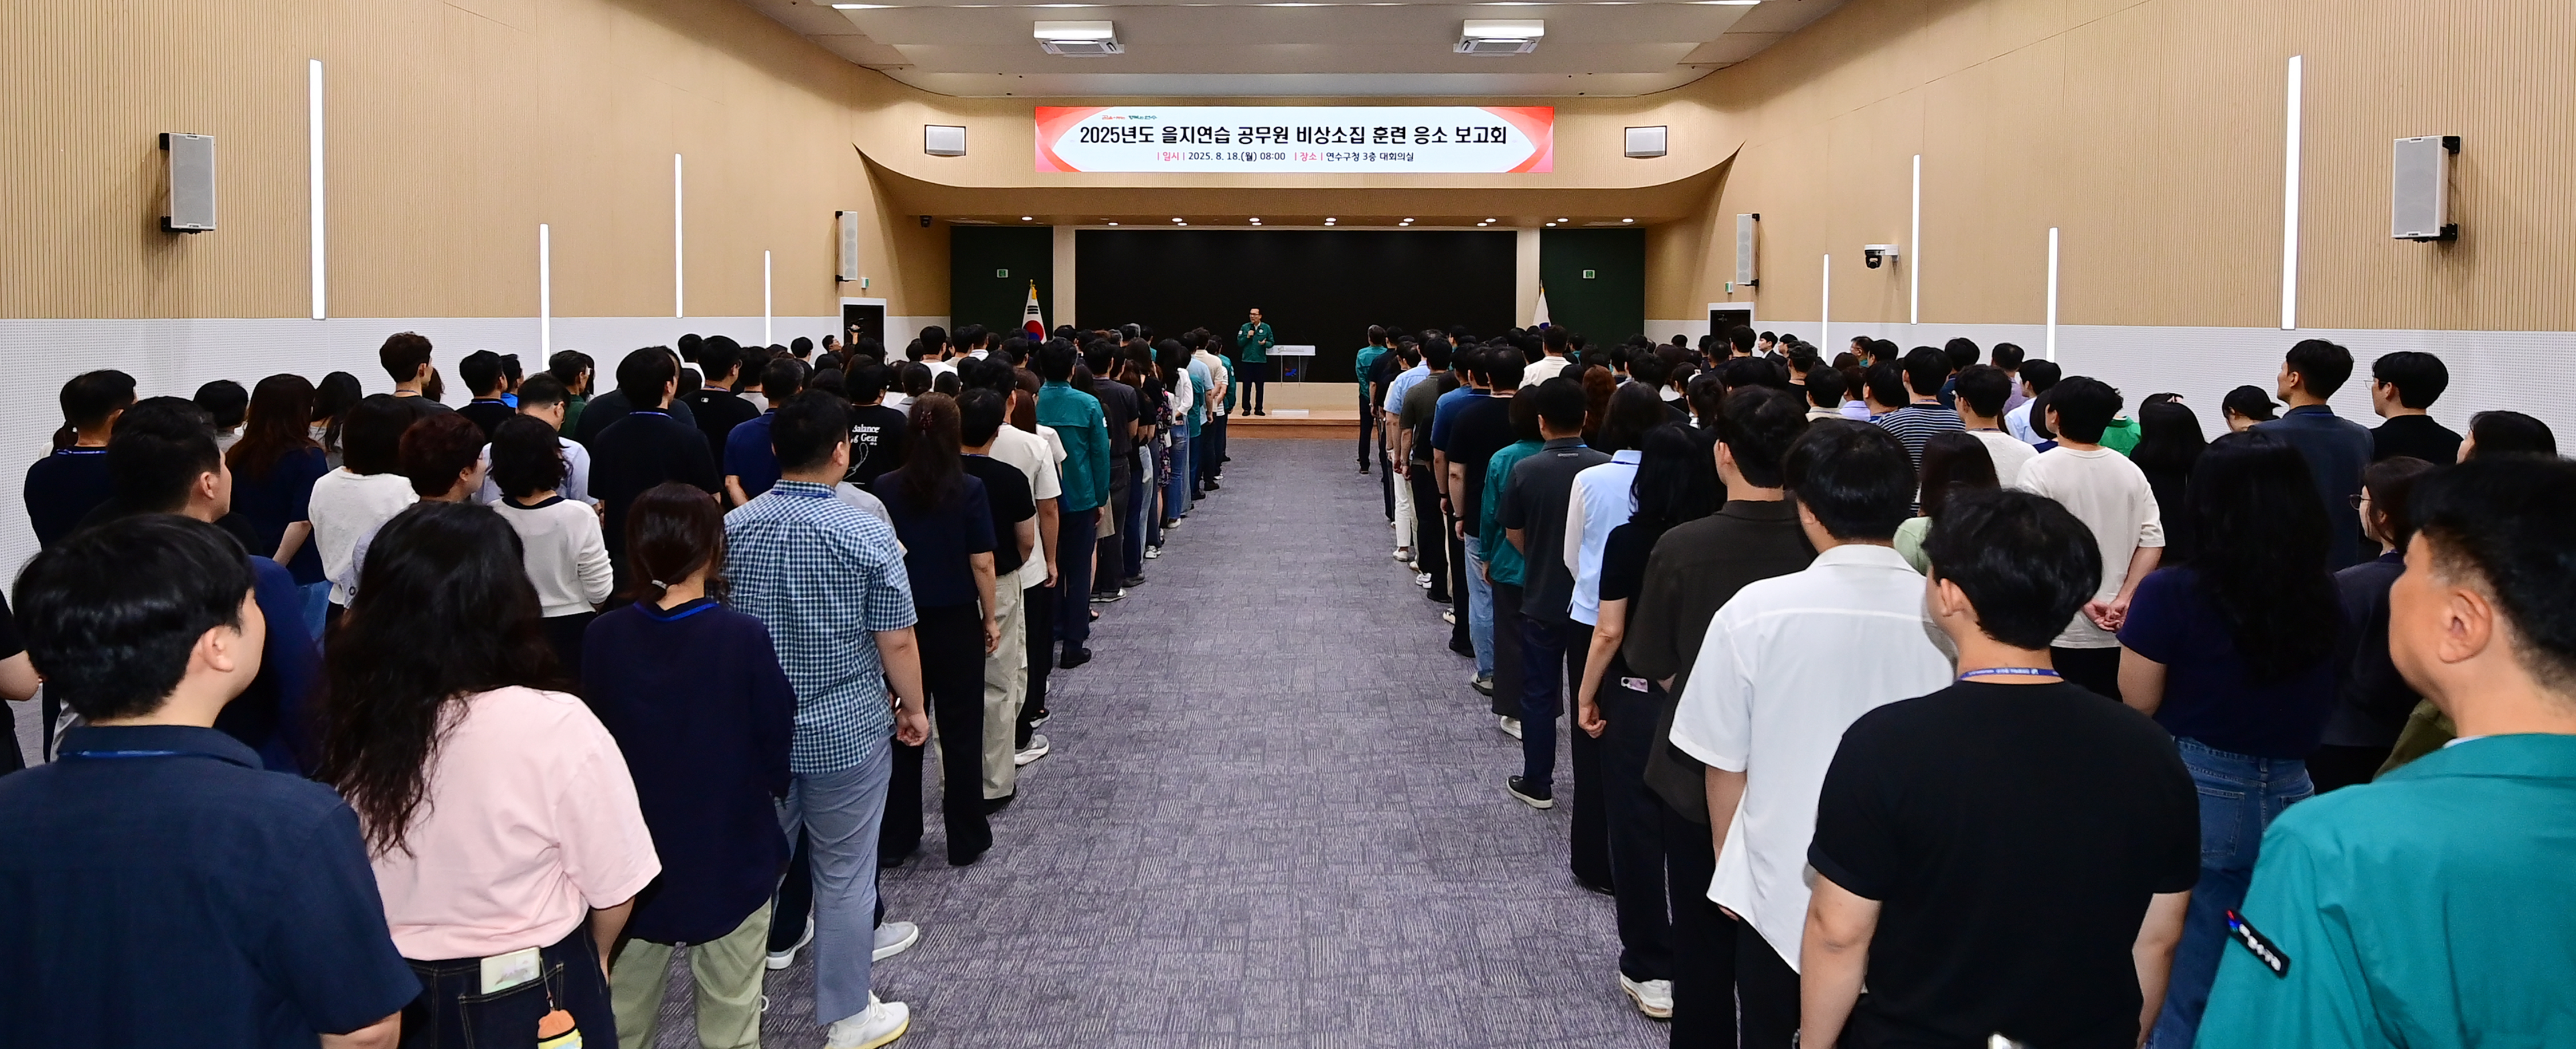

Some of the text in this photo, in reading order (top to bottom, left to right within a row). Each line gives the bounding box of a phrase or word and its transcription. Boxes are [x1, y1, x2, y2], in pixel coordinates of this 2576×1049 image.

[1080, 126, 1506, 144] 2025년도 을지연습 공무원 비상소집 훈련 응소 보고회
[1163, 152, 1179, 161] 일시
[1216, 152, 1224, 160] 8.
[1301, 152, 1413, 161] 장소 연수구청 3층 대회의실
[860, 433, 878, 442] Gear
